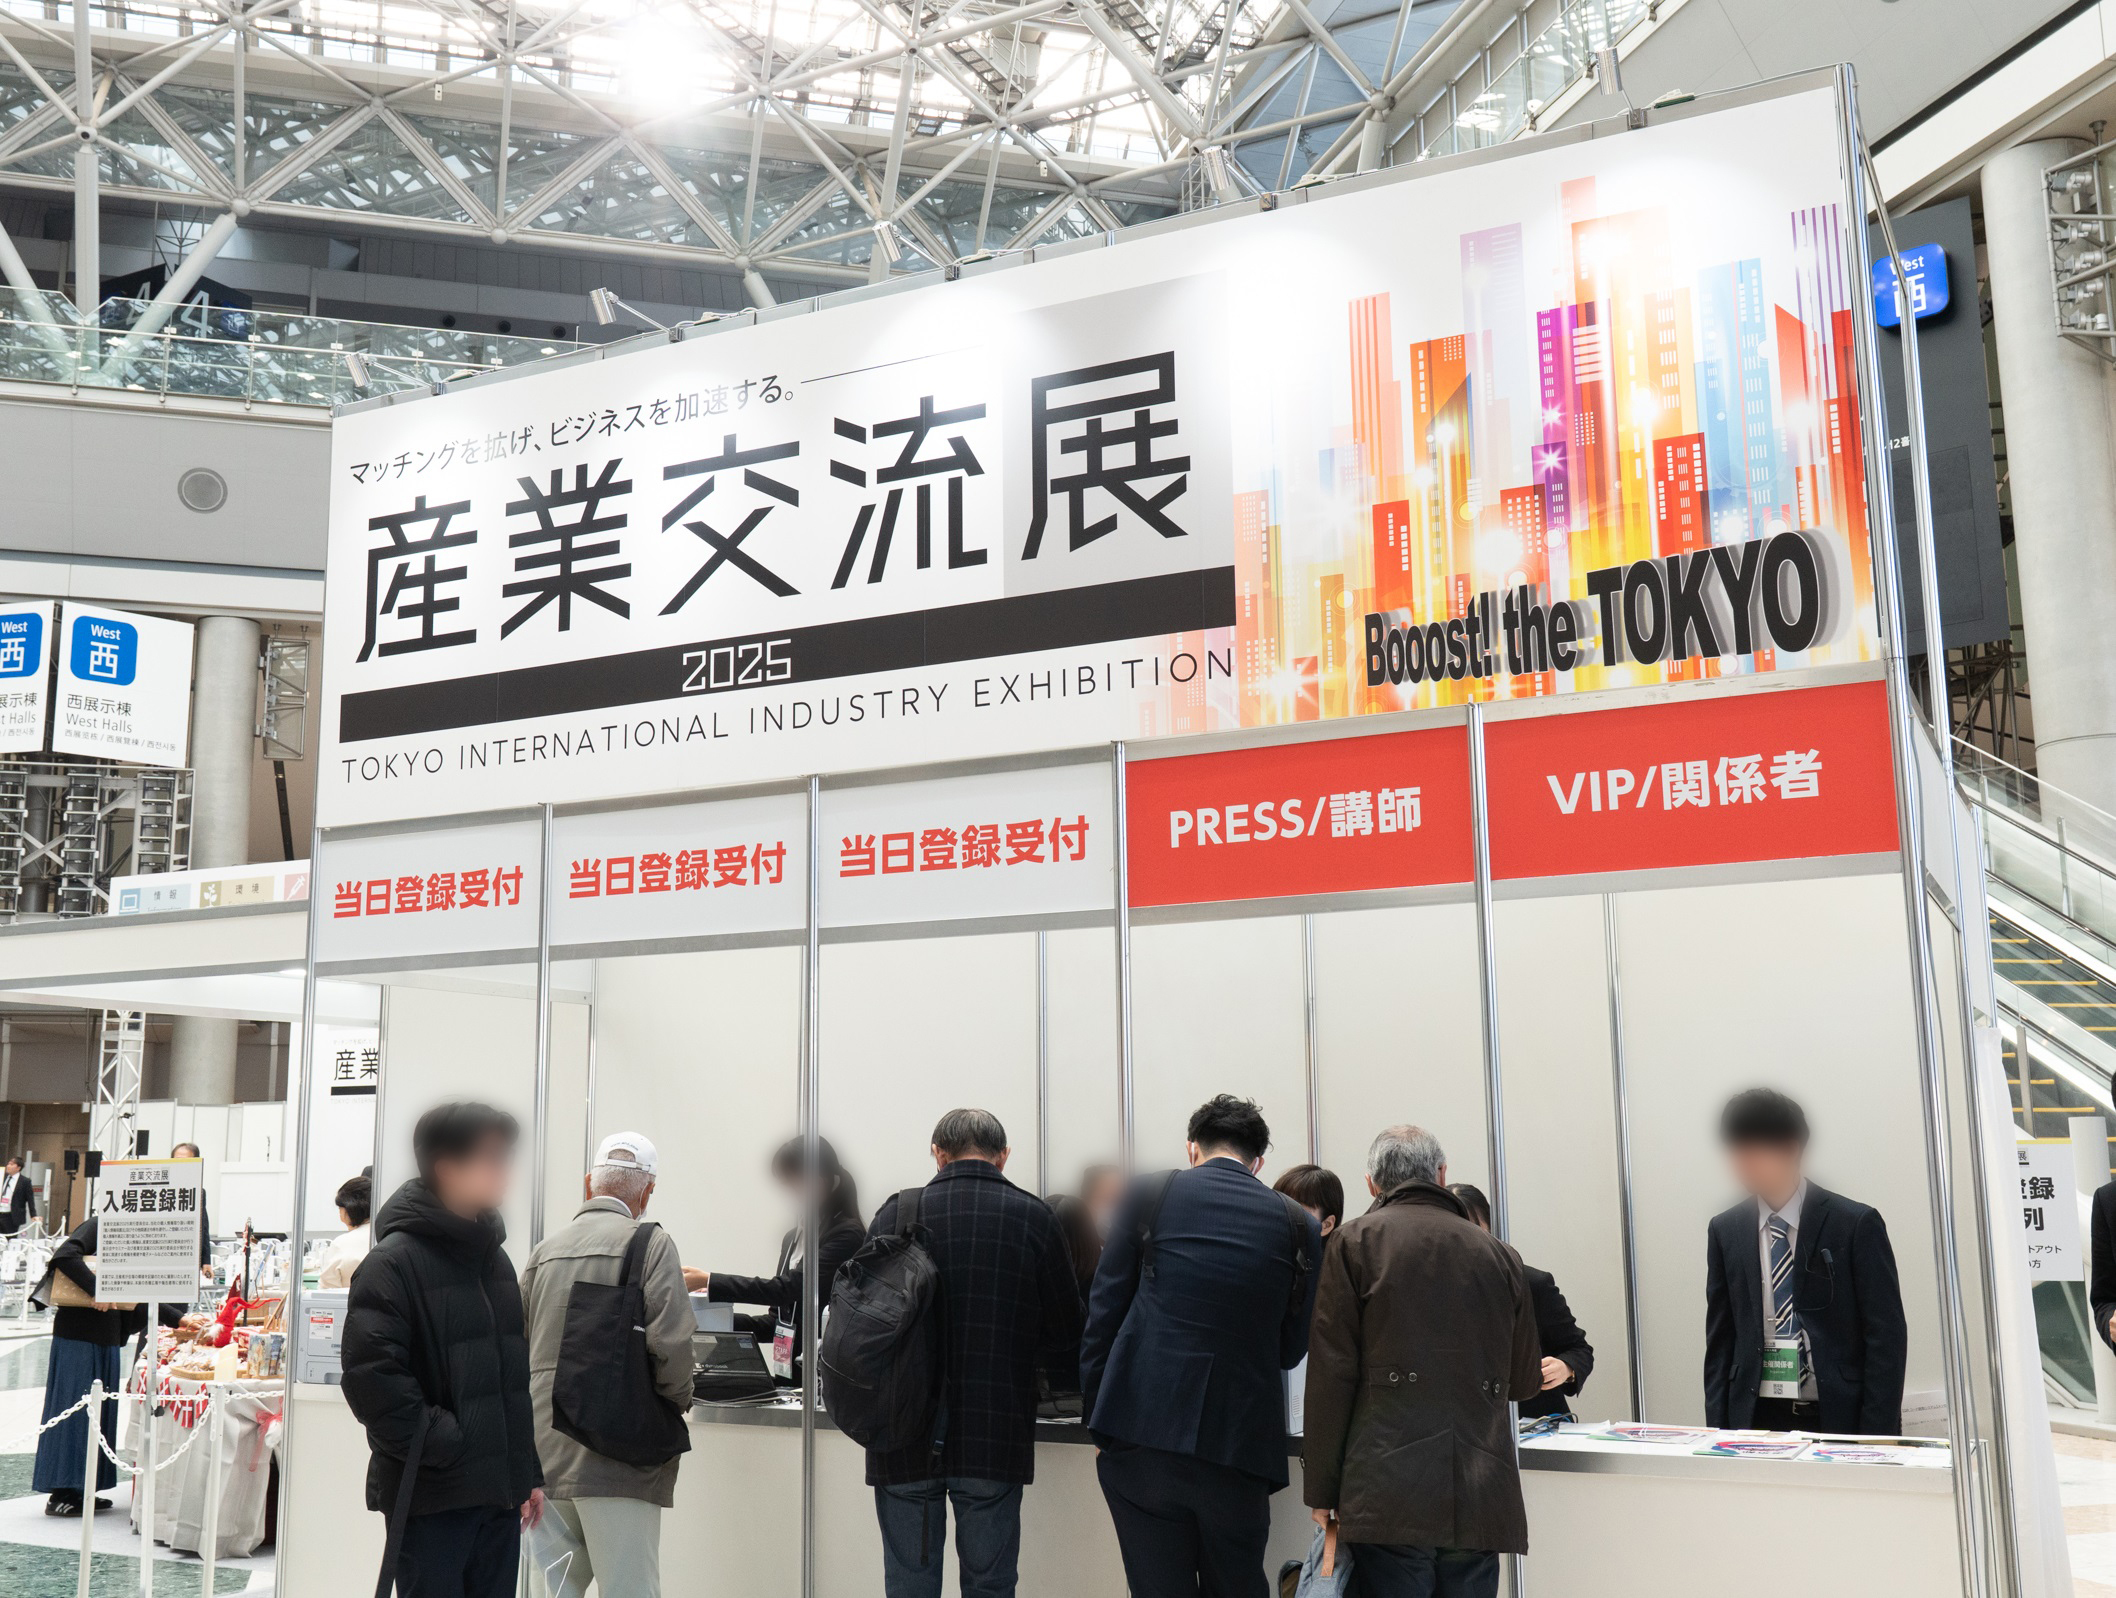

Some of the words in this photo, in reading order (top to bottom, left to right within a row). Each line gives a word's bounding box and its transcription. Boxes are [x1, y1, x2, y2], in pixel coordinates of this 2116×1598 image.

[181, 290, 209, 338] 4
[349, 374, 795, 485] マッチングを拡げ、ビジネスを加速する。
[355, 350, 1192, 664] 産業交流展
[1, 621, 28, 633] West
[91, 624, 121, 640] West
[1364, 592, 1493, 687] Booost!
[1502, 584, 1578, 676] the
[1586, 531, 1822, 667] TOKYO
[0, 637, 26, 673] 西
[89, 641, 119, 678] 西
[682, 638, 792, 692] 2025
[9, 711, 36, 724] Halls
[66, 713, 97, 729] West
[102, 718, 133, 734] Halls
[67, 693, 132, 717] 西展示棟
[341, 748, 444, 784] TOKYO
[459, 712, 729, 770] INTERNATIONAL
[749, 683, 949, 735] INDUSTRY
[973, 647, 1233, 708] EXHIBITION
[1546, 748, 1823, 815] VIP/関係者
[1170, 786, 1422, 848] PRESS/講師
[569, 841, 786, 899] 当日登録受付
[839, 815, 1090, 878] 当日登録受付
[333, 864, 524, 919] 当日登録受付
[334, 1048, 378, 1080] 産業
[129, 1170, 169, 1181] 産業交流展
[103, 1187, 196, 1213] 入場登録制
